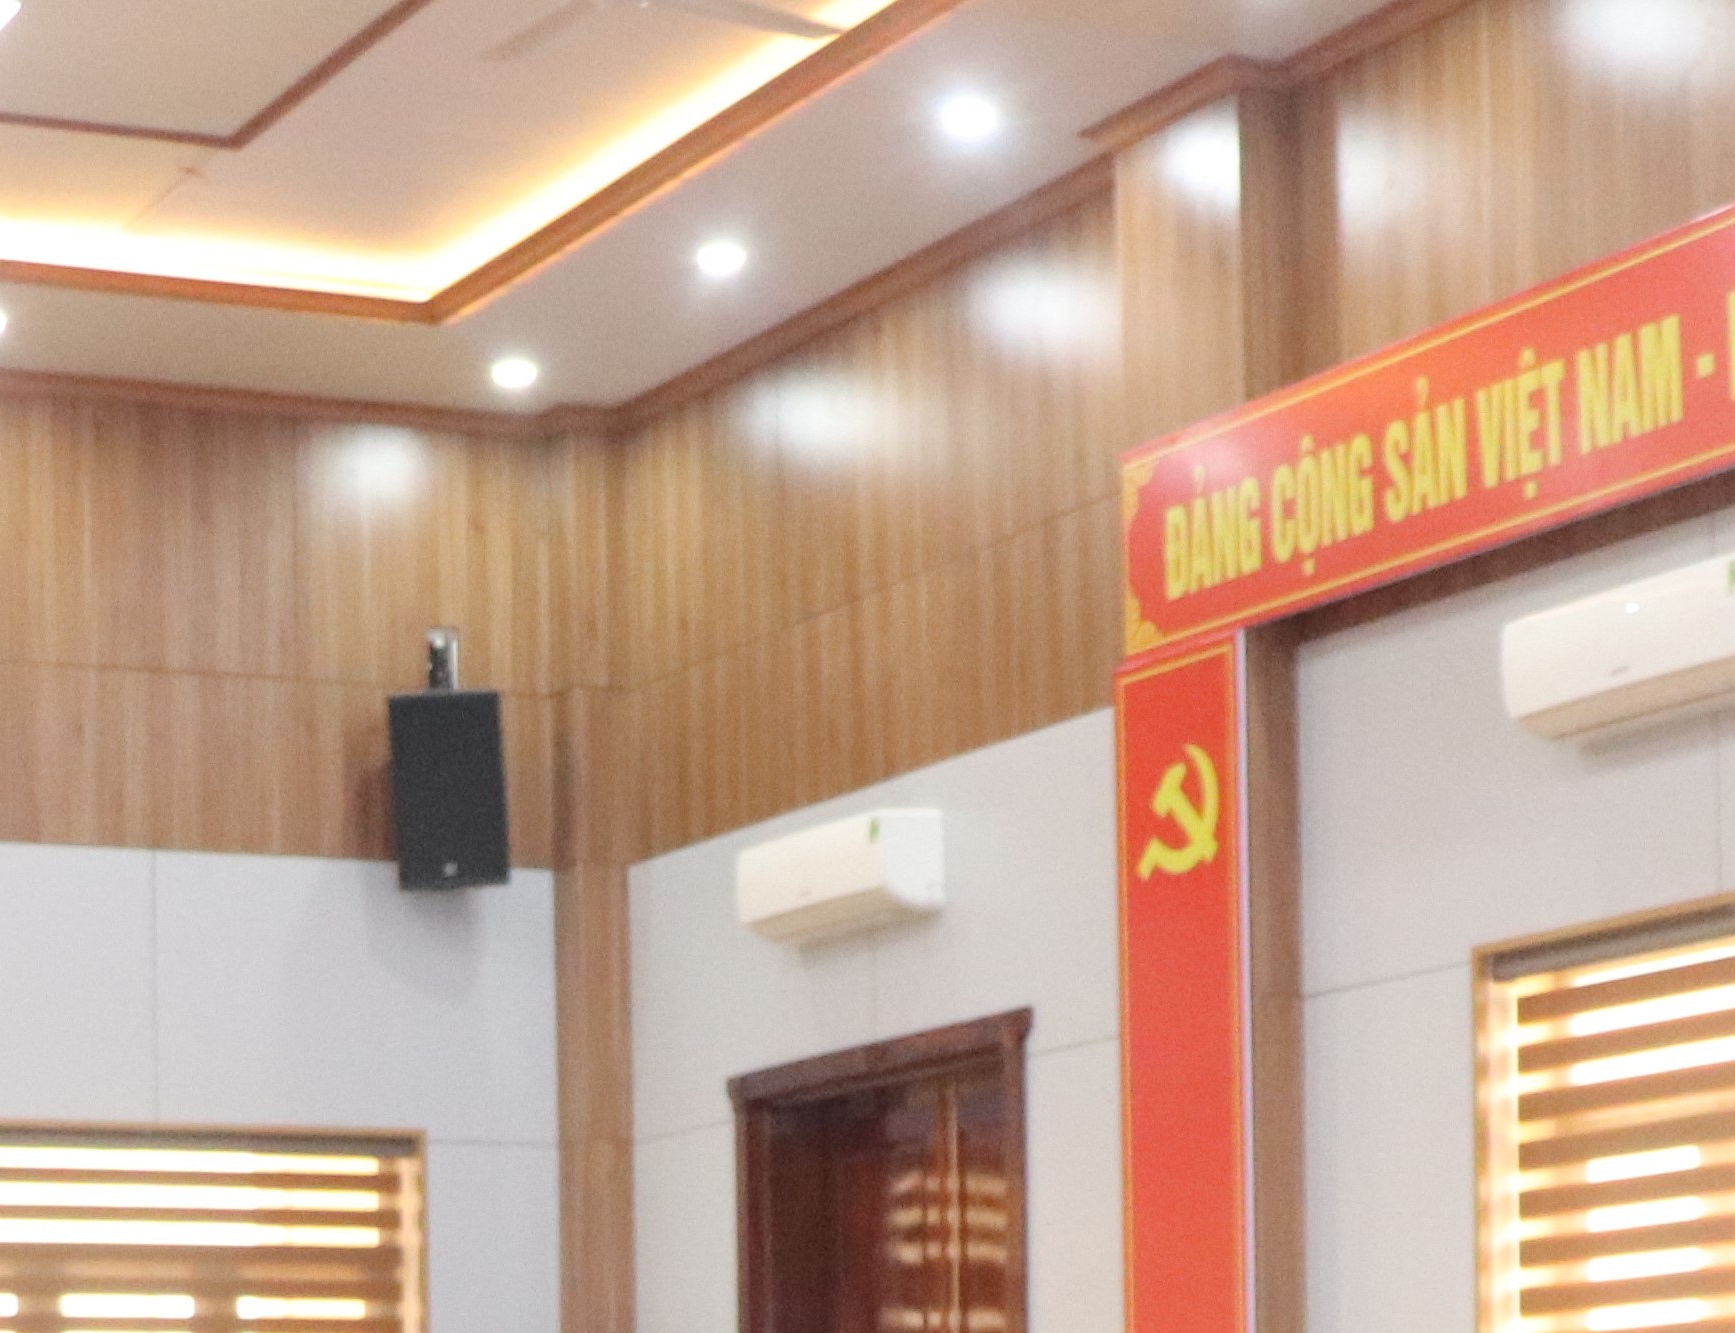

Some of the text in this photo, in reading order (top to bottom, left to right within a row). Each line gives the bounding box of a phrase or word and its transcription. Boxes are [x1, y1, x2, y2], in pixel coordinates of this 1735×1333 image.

[1165, 465, 1261, 601] ĐẢNG
[1271, 434, 1374, 576] CỘNG
[1384, 375, 1467, 523] SẢN
[1475, 346, 1565, 499] VIỆT
[1576, 314, 1682, 455] NAM
